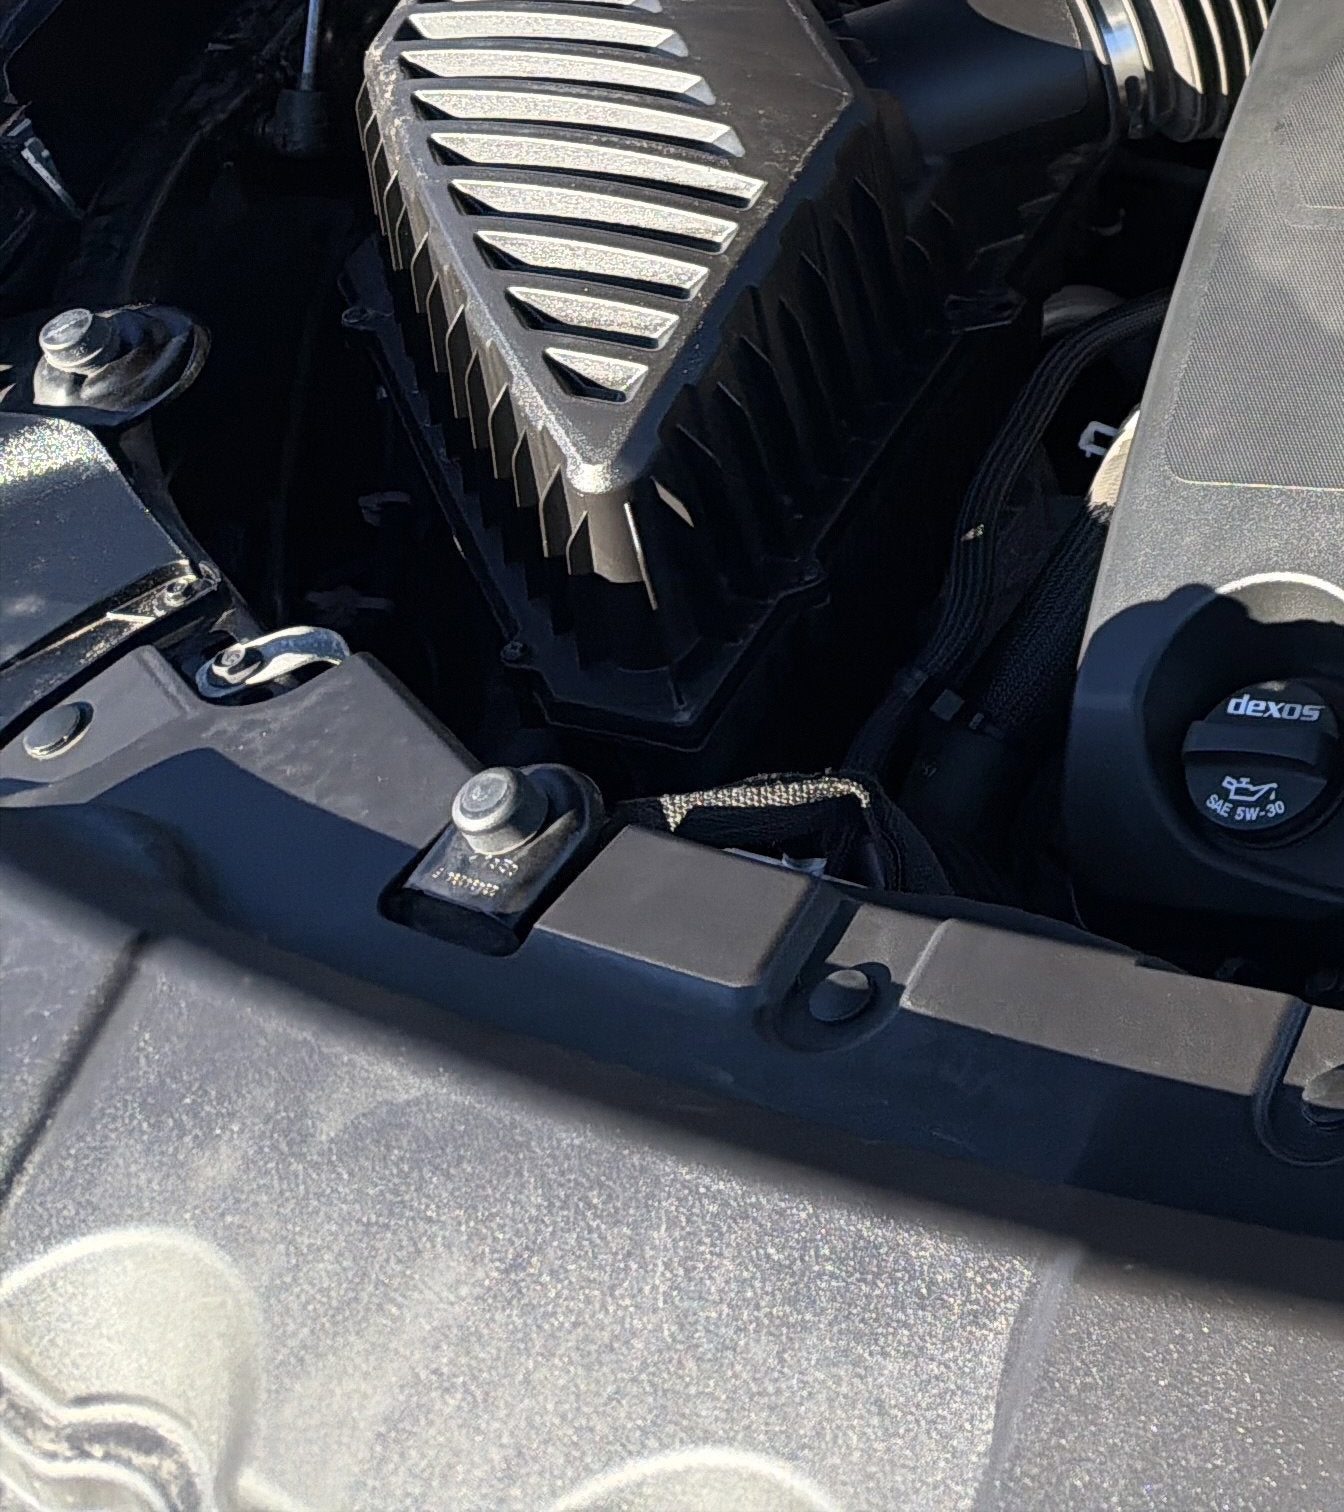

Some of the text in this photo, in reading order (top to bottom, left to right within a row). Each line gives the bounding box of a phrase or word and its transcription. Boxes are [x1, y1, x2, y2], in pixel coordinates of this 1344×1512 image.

[1226, 694, 1325, 721] dexos
[1206, 794, 1285, 821] SAE 5W-30
